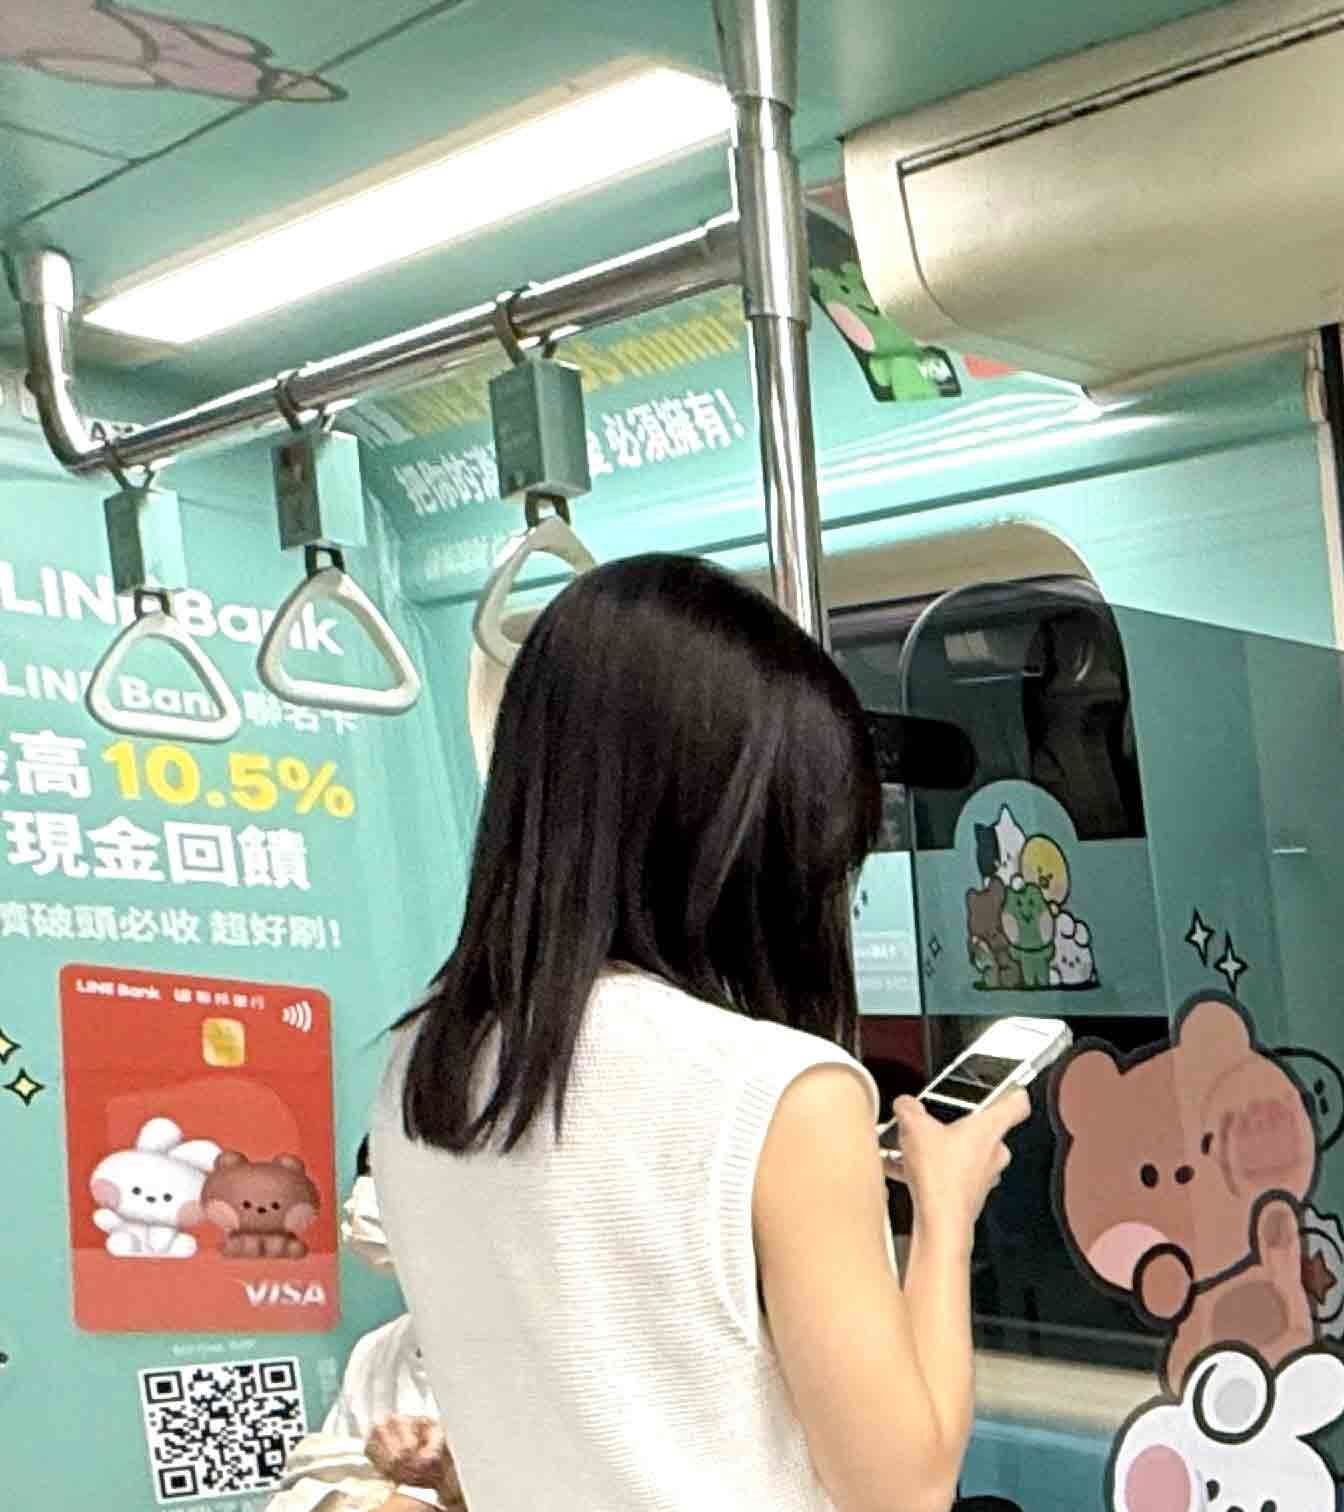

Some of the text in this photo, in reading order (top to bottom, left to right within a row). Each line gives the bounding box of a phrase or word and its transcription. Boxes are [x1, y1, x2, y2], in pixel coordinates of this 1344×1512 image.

[0, 729, 356, 819] 高 10.5%
[0, 810, 311, 891] 現金回饋
[240, 1278, 328, 1306] VISA
